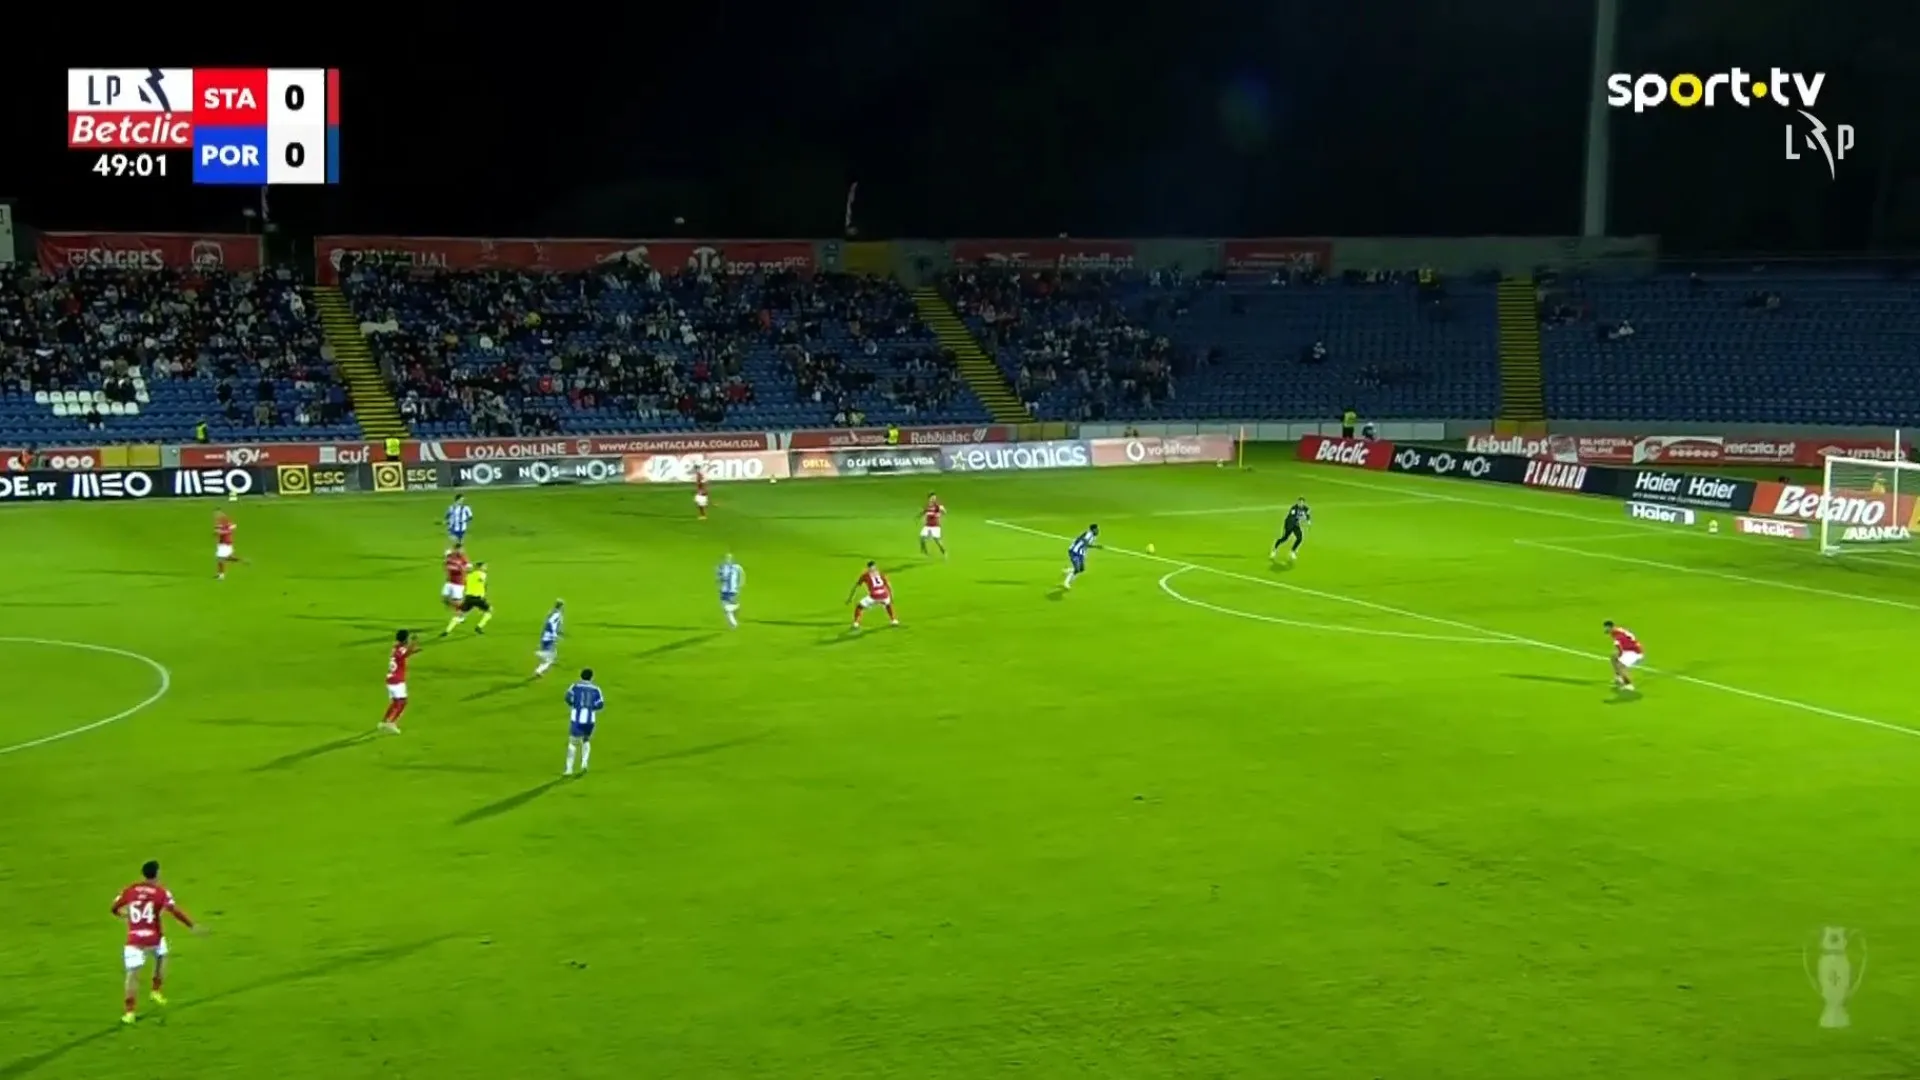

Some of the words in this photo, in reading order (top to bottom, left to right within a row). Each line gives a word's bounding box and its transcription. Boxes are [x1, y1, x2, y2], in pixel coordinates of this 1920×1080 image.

[88, 247, 163, 270] SAGRES
[910, 431, 971, 444] Robbialac
[1466, 435, 1548, 457] Lebull.pt
[338, 447, 369, 464] cuf
[466, 446, 505, 459] LOJA
[509, 442, 566, 457] ONLINE
[968, 441, 1087, 470] euronics
[1147, 441, 1201, 457] vodafone
[1315, 440, 1369, 465] Betclic
[1394, 449, 1420, 469] NOS
[460, 462, 502, 484] NOS
[519, 461, 560, 483] NOS
[576, 459, 615, 481] NOS
[847, 458, 855, 468] O
[912, 456, 935, 465] VIDA
[1428, 453, 1456, 473] NOS
[1463, 456, 1491, 477] NOS
[72, 471, 152, 497] MEO
[175, 469, 252, 494] MEO
[313, 471, 345, 485] ESC
[406, 469, 437, 482] ESC
[1523, 460, 1588, 489] PLACARD
[1635, 471, 1681, 493] Haier
[1687, 477, 1737, 499] Haier
[1632, 504, 1677, 523] Haier
[1774, 485, 1885, 525] Betano
[1744, 519, 1794, 538] Betclic
[1842, 526, 1911, 540] ABANCA
[129, 900, 155, 924] 64
